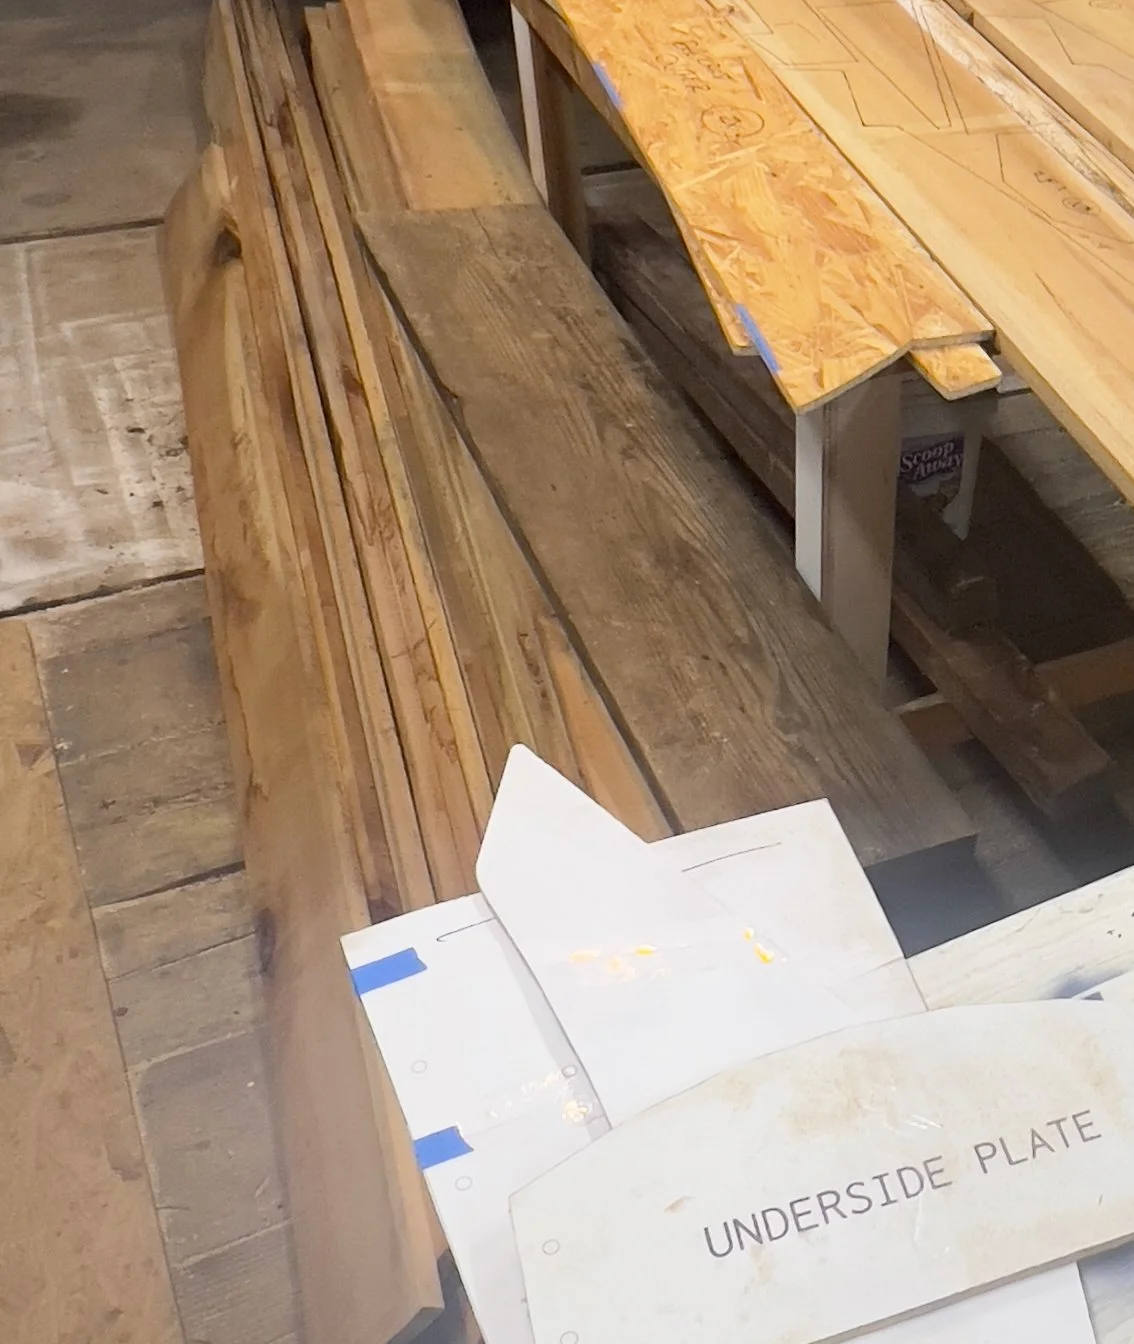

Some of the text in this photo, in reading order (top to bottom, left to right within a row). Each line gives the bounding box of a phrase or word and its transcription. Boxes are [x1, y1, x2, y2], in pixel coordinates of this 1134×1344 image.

[900, 442, 954, 472] Scoop
[913, 453, 963, 480] Away
[703, 1109, 1102, 1259] UNDERSIDE PLATE
